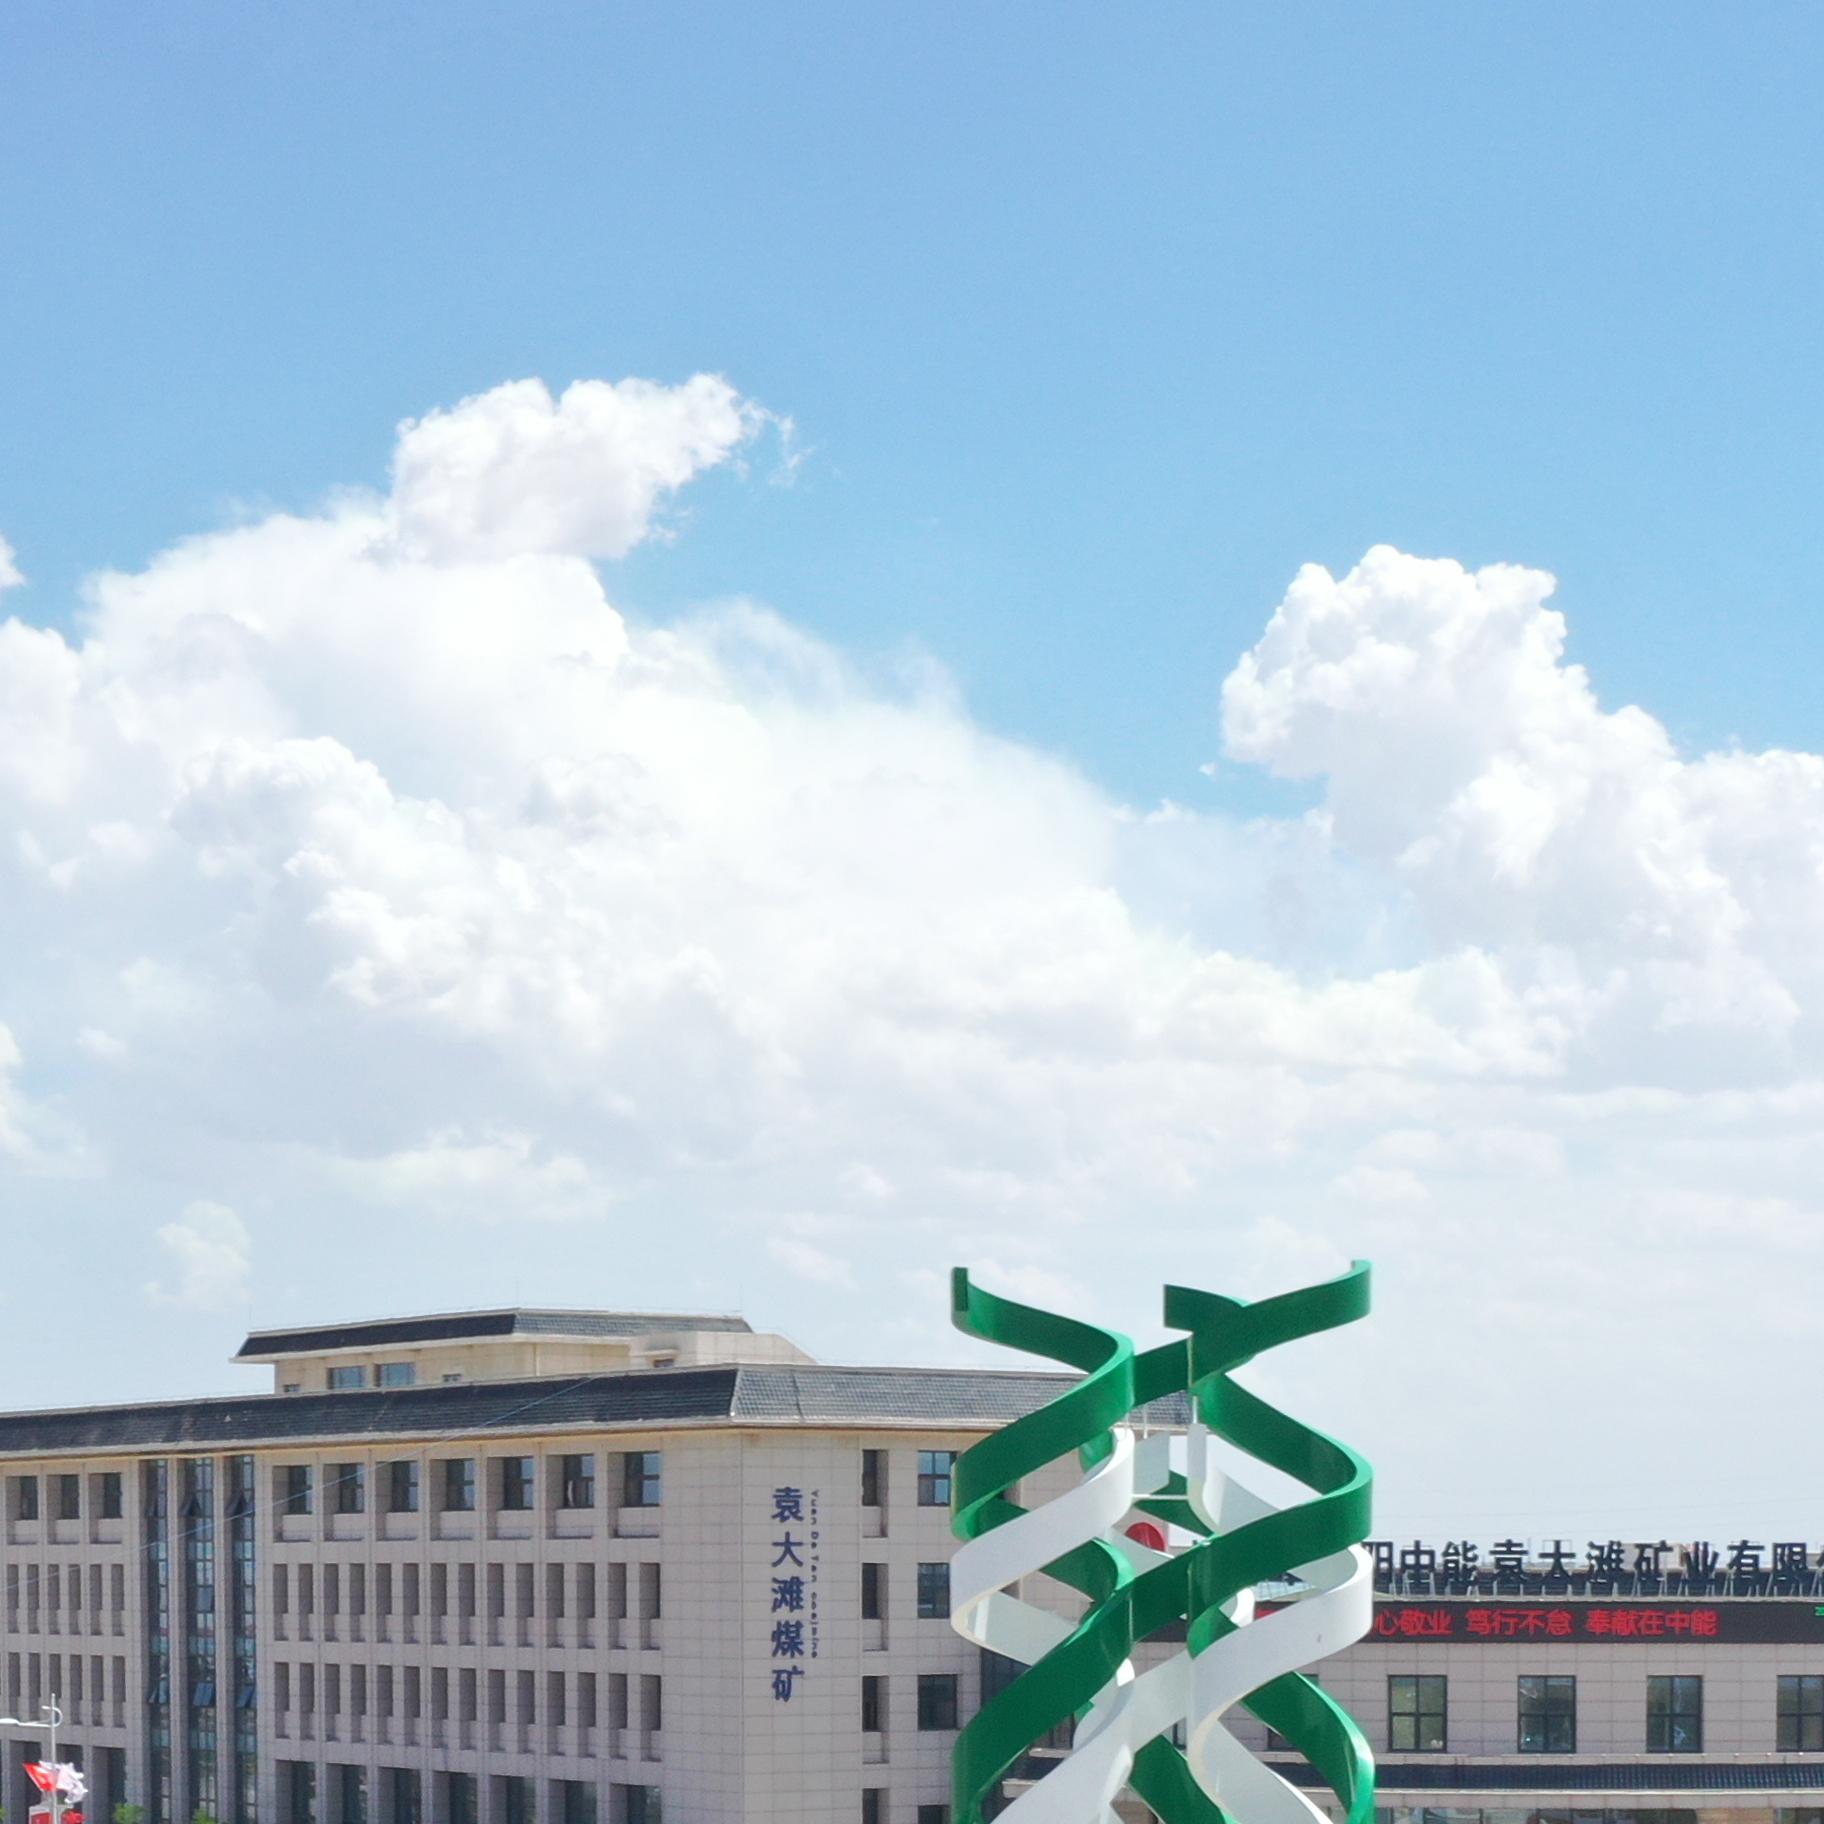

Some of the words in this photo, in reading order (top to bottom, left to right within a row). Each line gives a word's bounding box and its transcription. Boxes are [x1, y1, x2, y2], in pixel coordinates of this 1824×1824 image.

[771, 1486, 805, 1703] 袁大滩煤矿
[1466, 1609, 1574, 1636] 笃行不怠
[1584, 1609, 1719, 1637] 奉献在中能
